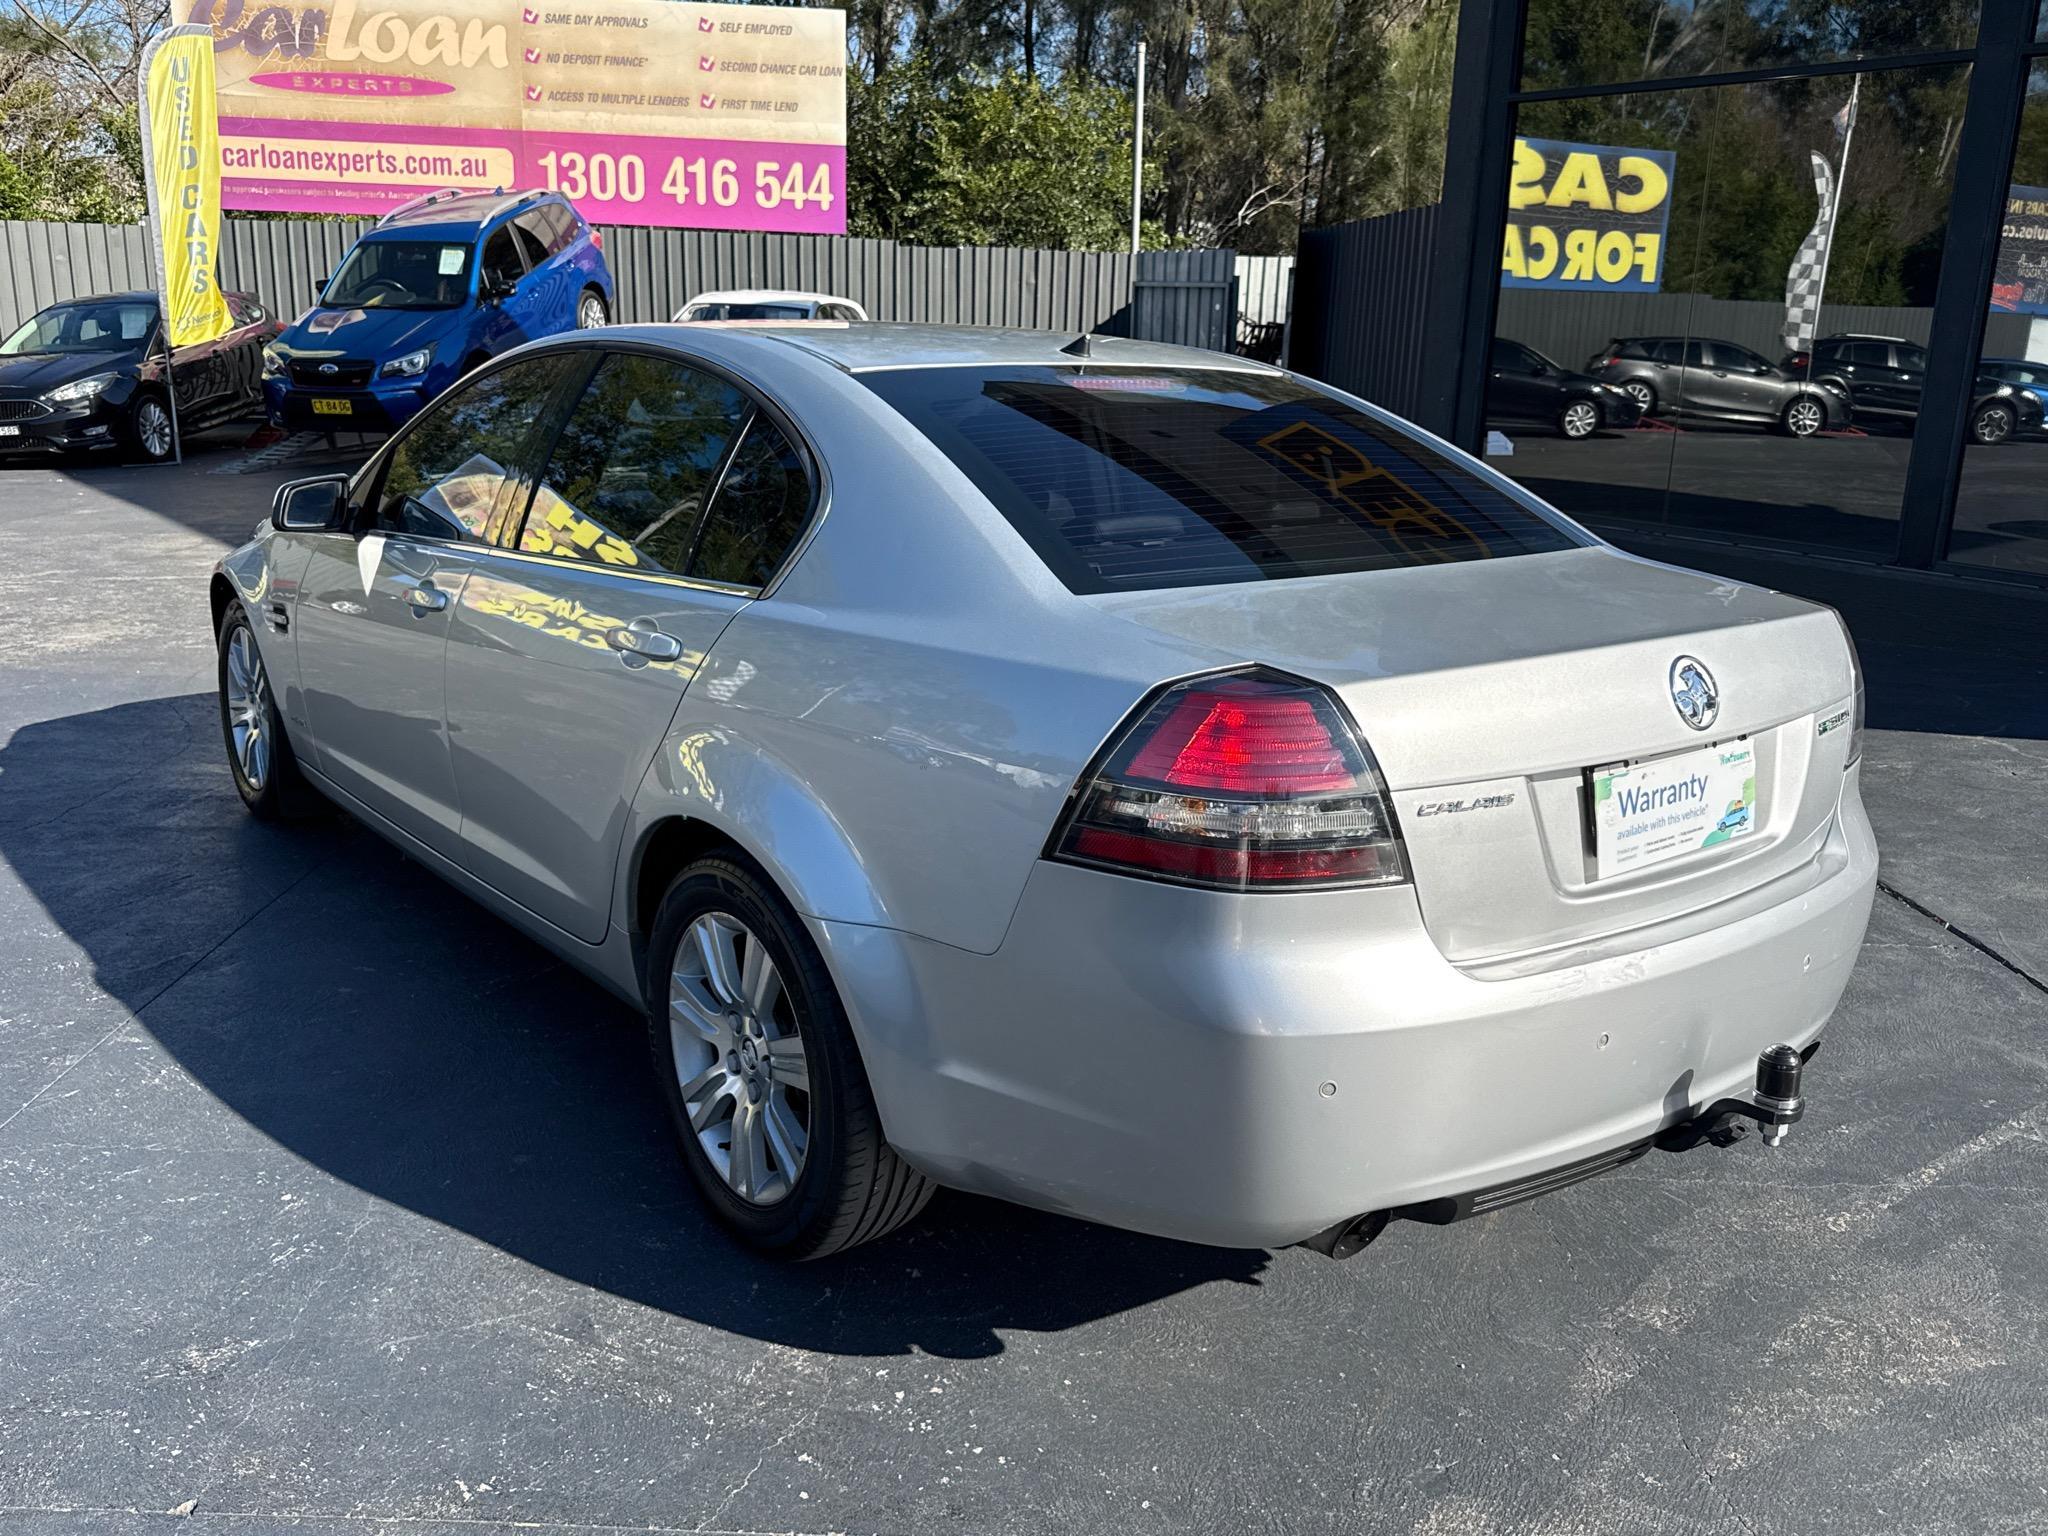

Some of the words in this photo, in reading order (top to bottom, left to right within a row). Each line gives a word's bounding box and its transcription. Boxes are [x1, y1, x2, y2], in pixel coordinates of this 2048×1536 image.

[545, 13, 573, 25] SAME
[574, 15, 593, 27] DAY
[594, 16, 648, 29] APPROVALS
[719, 22, 743, 34] SELF
[745, 23, 792, 36] EMPLOYED
[546, 53, 560, 64] NO
[562, 54, 602, 66] DEPOSIT
[720, 61, 757, 73] SECOND
[759, 63, 797, 75] CHANCE
[799, 64, 818, 76] CAR
[820, 65, 842, 77] LOAN
[293, 75, 413, 92] EXPERTS
[548, 91, 585, 103] ACCESS
[587, 92, 600, 103] TO
[601, 93, 645, 105] MULTIPLE
[647, 95, 690, 107] LENDERS
[721, 98, 746, 110] FIRST
[749, 100, 772, 112] TIME
[774, 100, 798, 113] LEND
[170, 56, 198, 170] USED
[222, 143, 487, 178] carloanexperts.com.au
[538, 150, 645, 202] 1300
[661, 156, 739, 207] 416
[754, 161, 834, 211] 544
[181, 184, 210, 294] CARS
[1617, 773, 1708, 818] Warranty
[1617, 822, 1649, 840] available
[1650, 817, 1666, 831] with
[1667, 813, 1682, 827] this
